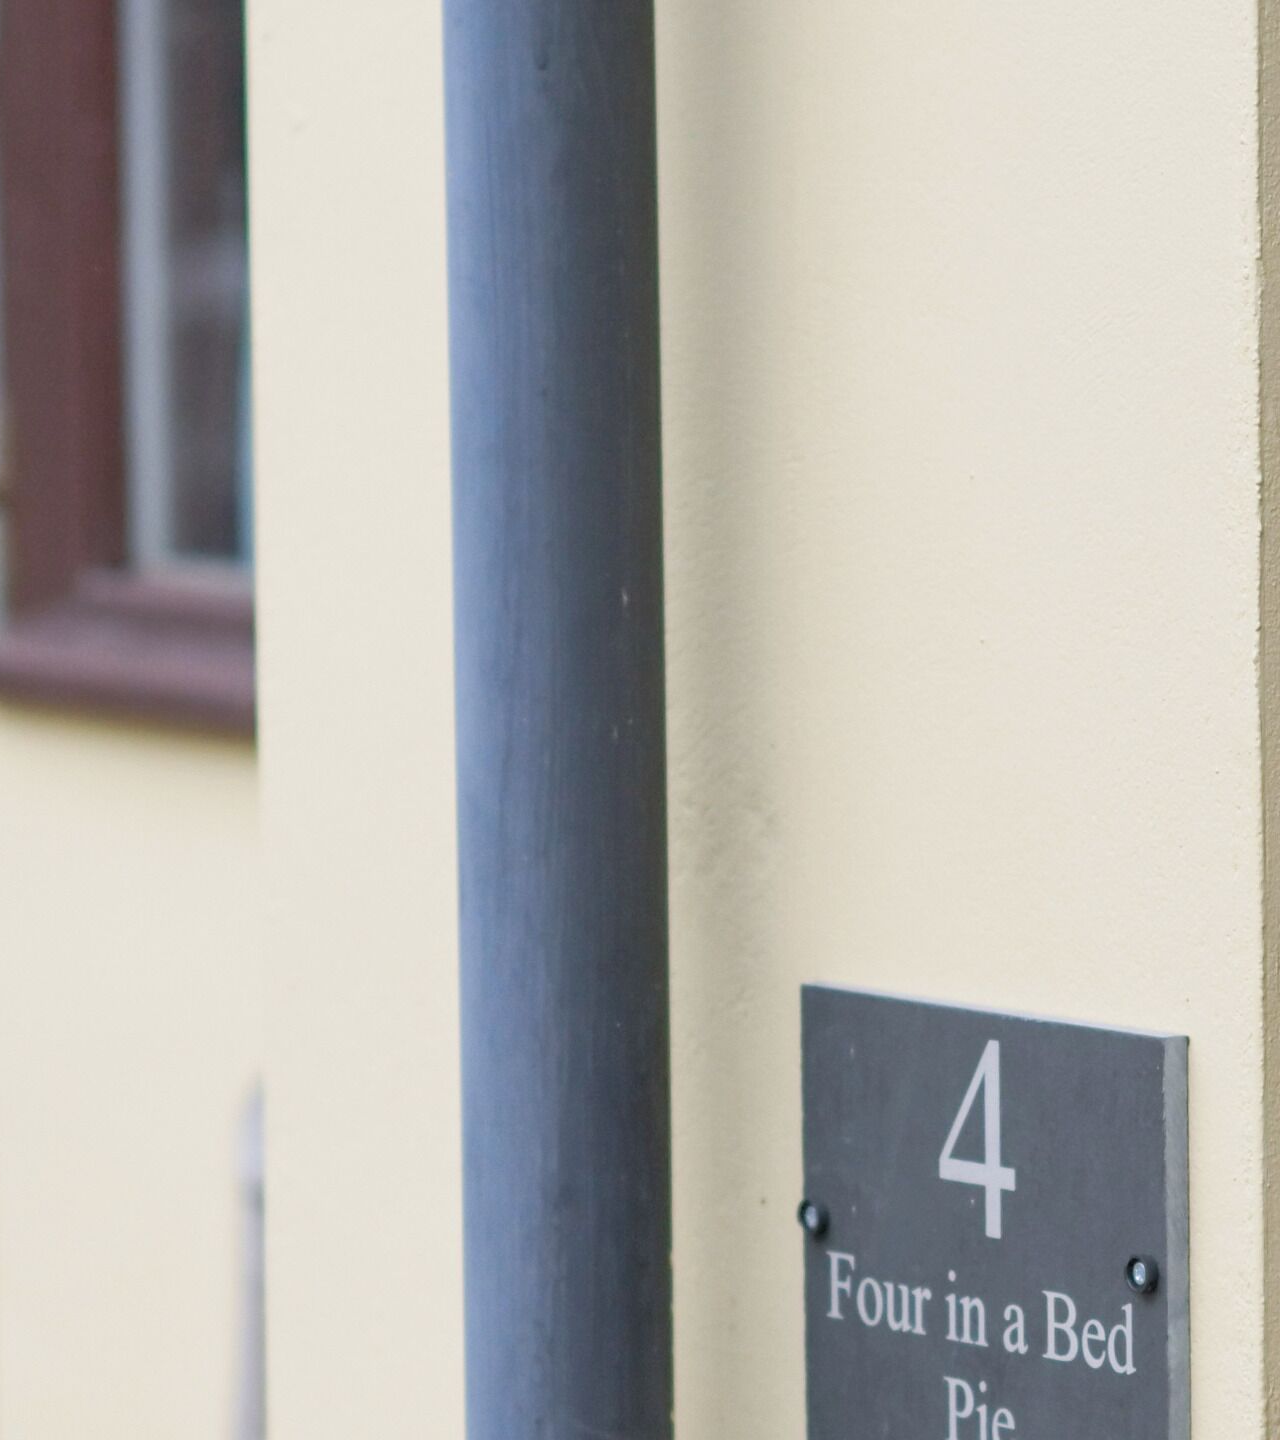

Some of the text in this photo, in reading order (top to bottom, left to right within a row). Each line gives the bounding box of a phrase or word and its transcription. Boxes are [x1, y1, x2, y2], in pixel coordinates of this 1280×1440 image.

[938, 1039, 1016, 1239] 4
[826, 1251, 1137, 1376] Four in a Bed
